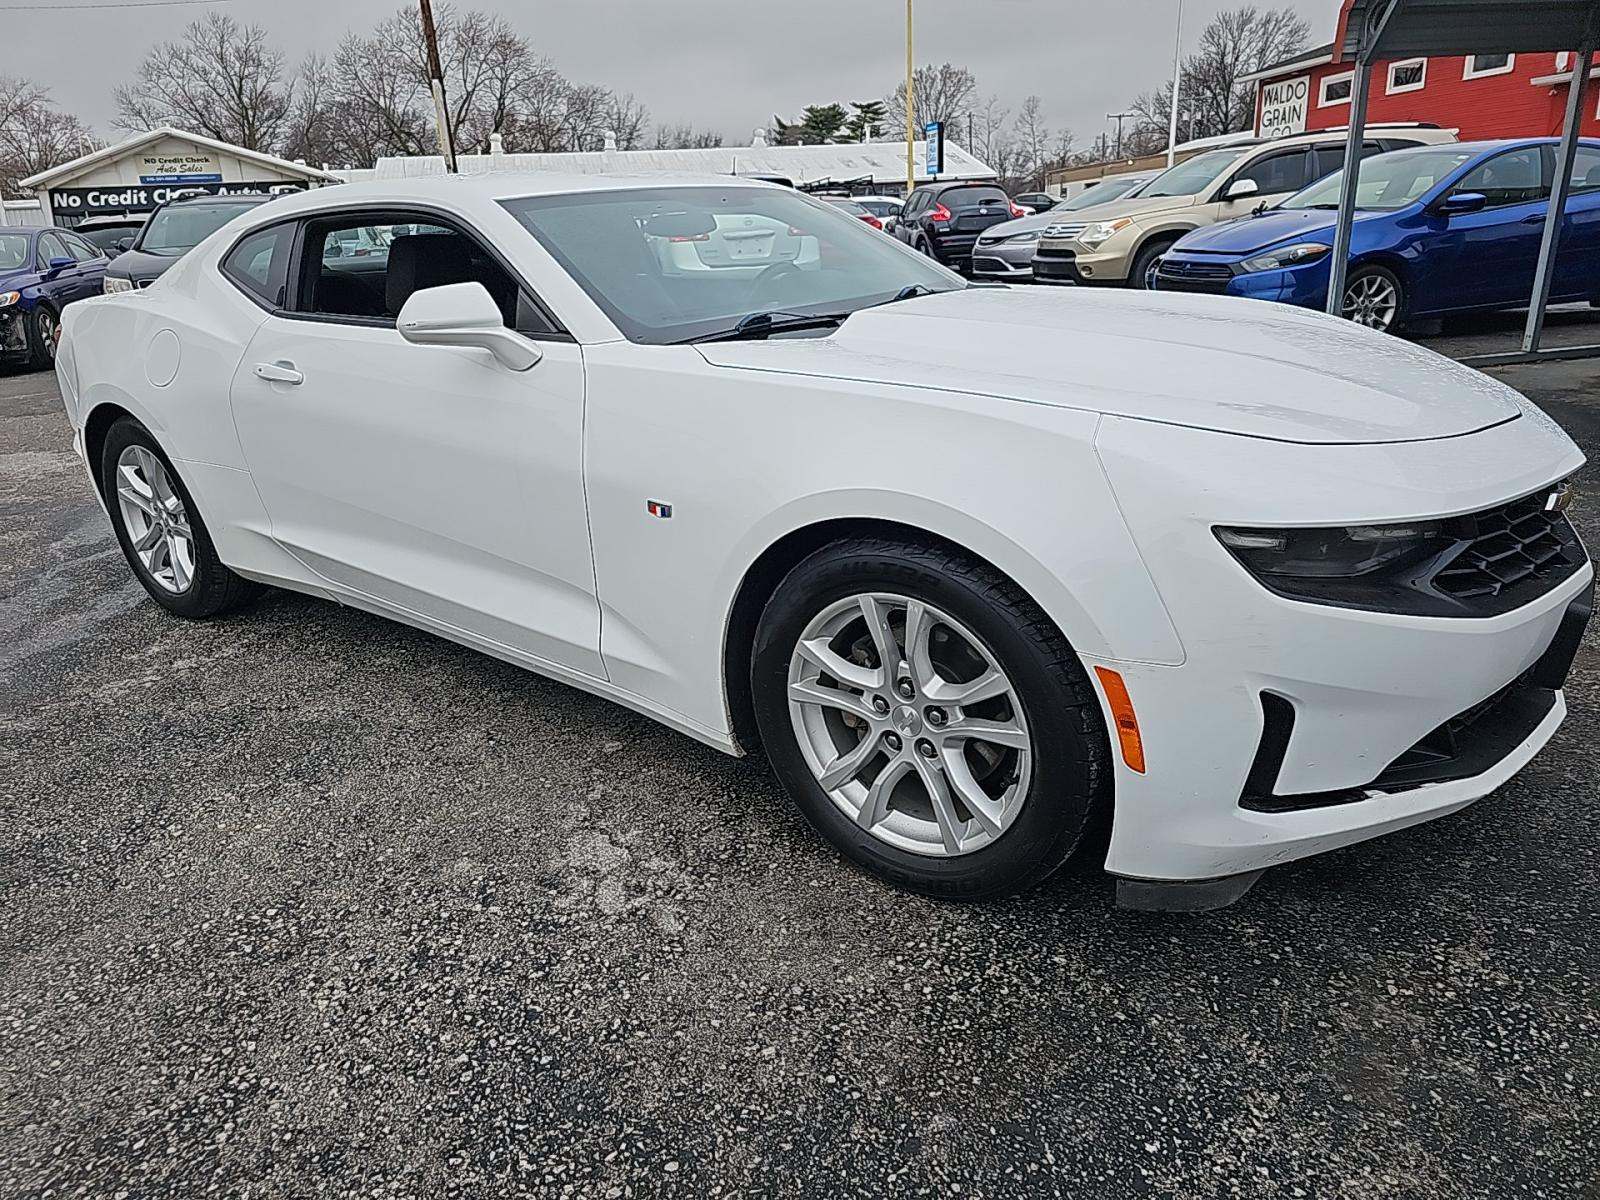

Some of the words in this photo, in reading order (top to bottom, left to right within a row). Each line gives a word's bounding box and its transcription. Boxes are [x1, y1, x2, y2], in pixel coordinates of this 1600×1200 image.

[1264, 81, 1307, 107] WALDO
[1262, 103, 1302, 128] GRAIN
[155, 164, 177, 174] Auto
[179, 163, 203, 173] Sales
[53, 192, 82, 208] No
[87, 189, 148, 207] Credit
